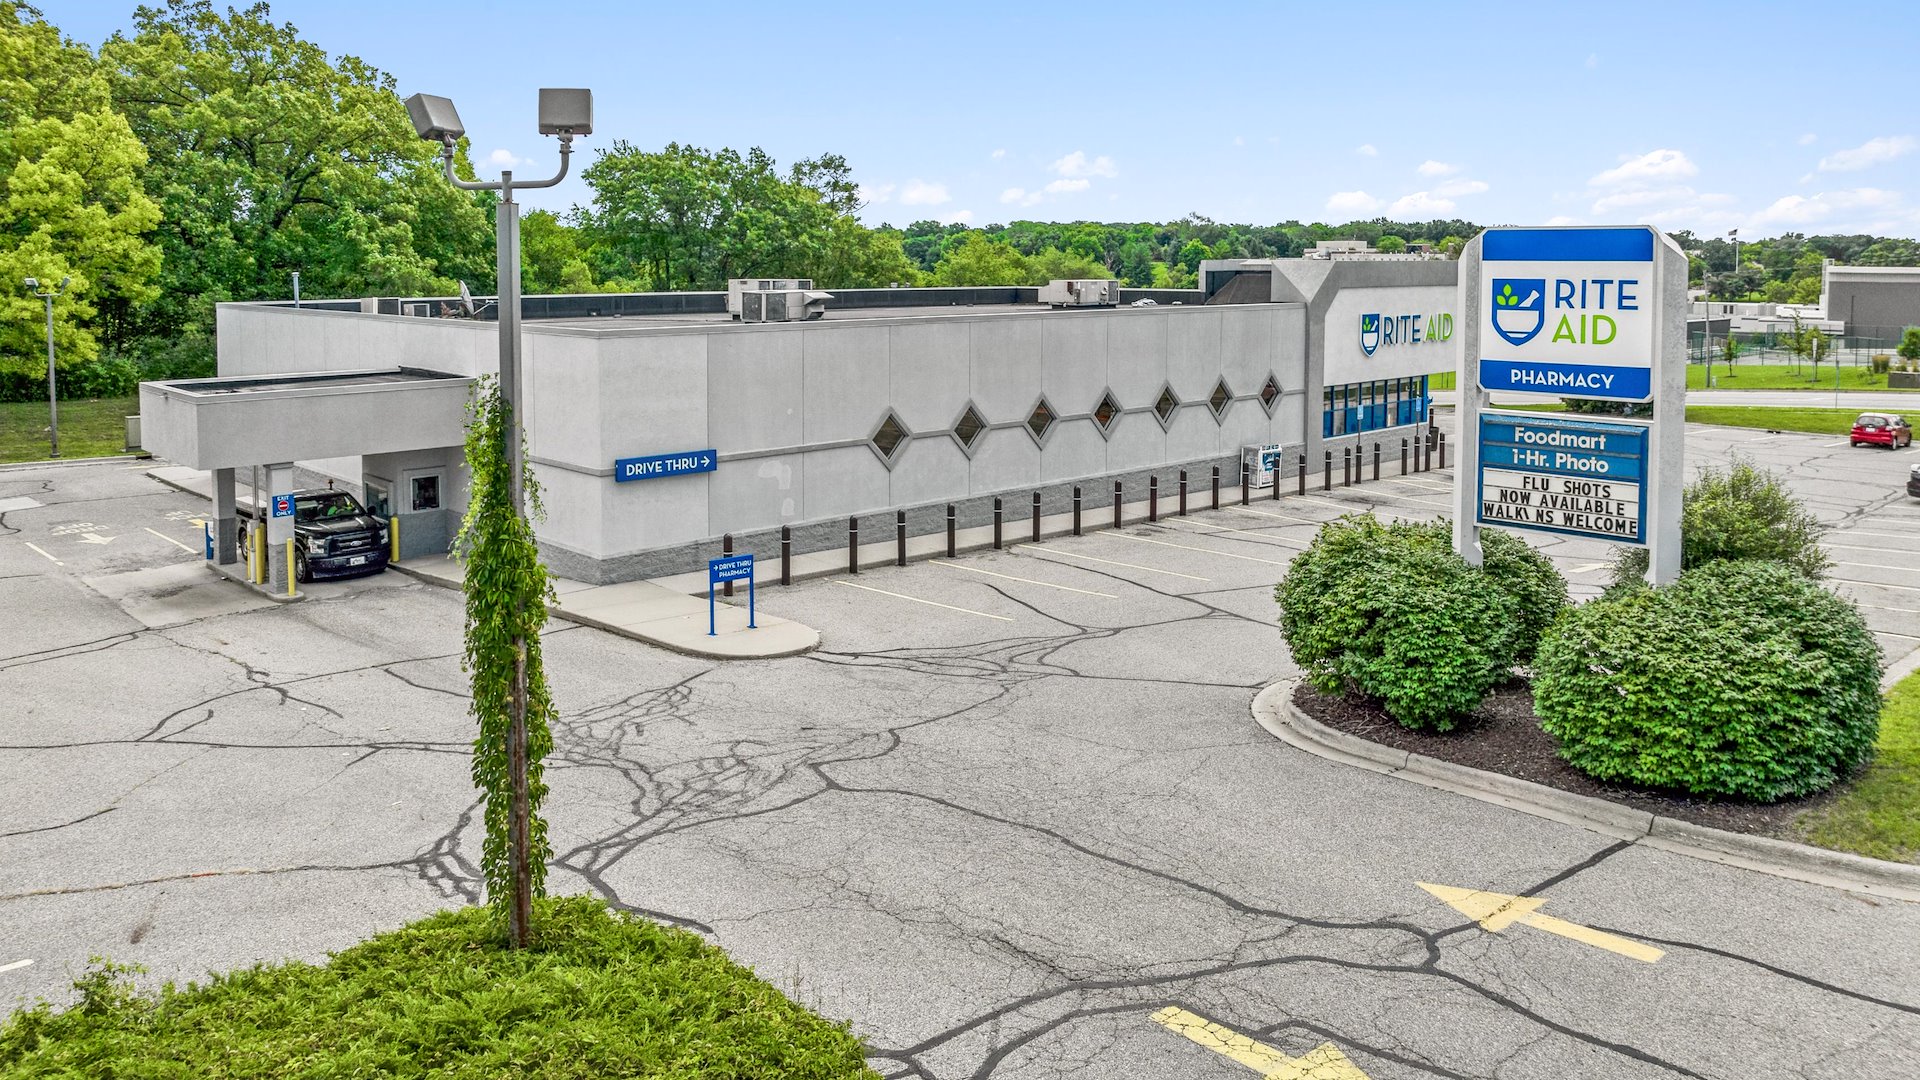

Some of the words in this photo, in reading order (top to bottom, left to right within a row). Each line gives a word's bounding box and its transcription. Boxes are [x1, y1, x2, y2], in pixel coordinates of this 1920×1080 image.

[1555, 279, 1639, 311] RITE
[1382, 314, 1422, 345] RITE
[1424, 312, 1454, 342] AID
[1551, 313, 1617, 345] AID
[1510, 368, 1615, 389] PHARMACY
[1514, 426, 1607, 450] Foodmart
[625, 460, 663, 477] DRIVE
[665, 456, 698, 472] THRU
[1512, 448, 1550, 468] 1-Hr.
[1555, 452, 1610, 473] Photo
[1523, 476, 1550, 491] FLU
[1563, 480, 1611, 499] SHOTS
[1500, 489, 1531, 505] NOW
[1539, 494, 1625, 516] AVAILABLE
[1563, 512, 1638, 534] WELCOME
[718, 561, 736, 571] DRIVE
[736, 559, 752, 568] THRU
[718, 567, 751, 578] PHARMACY
